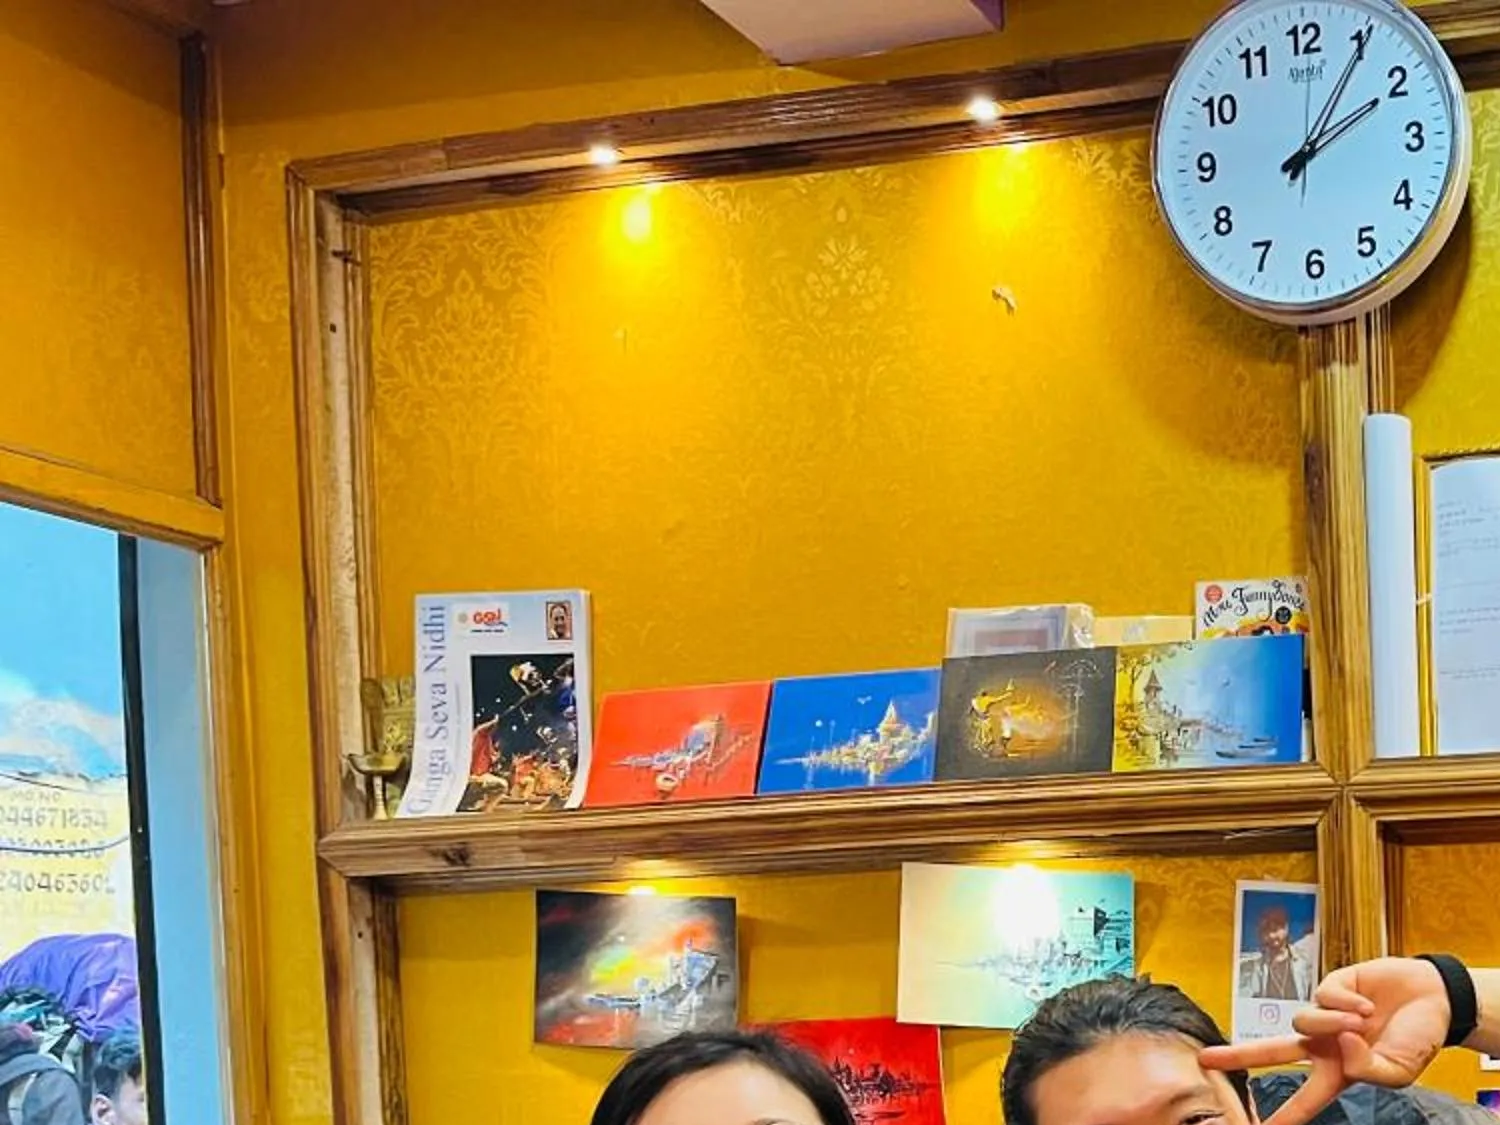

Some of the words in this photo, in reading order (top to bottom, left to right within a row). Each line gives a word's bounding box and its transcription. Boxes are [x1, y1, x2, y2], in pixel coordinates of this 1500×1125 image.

[1286, 22, 1321, 56] 12
[1350, 28, 1366, 61] 1
[1239, 46, 1268, 80] 11
[1387, 65, 1408, 98] 2
[1202, 94, 1238, 127] 10
[1404, 121, 1425, 152] 3
[1196, 152, 1217, 183] 9
[1393, 179, 1414, 211] 4
[1213, 206, 1234, 236] 8
[1252, 240, 1273, 272] 7
[1356, 226, 1377, 258] 5
[1305, 249, 1325, 280] 6
[422, 605, 447, 673] Nidhi
[426, 682, 449, 740] Seva
